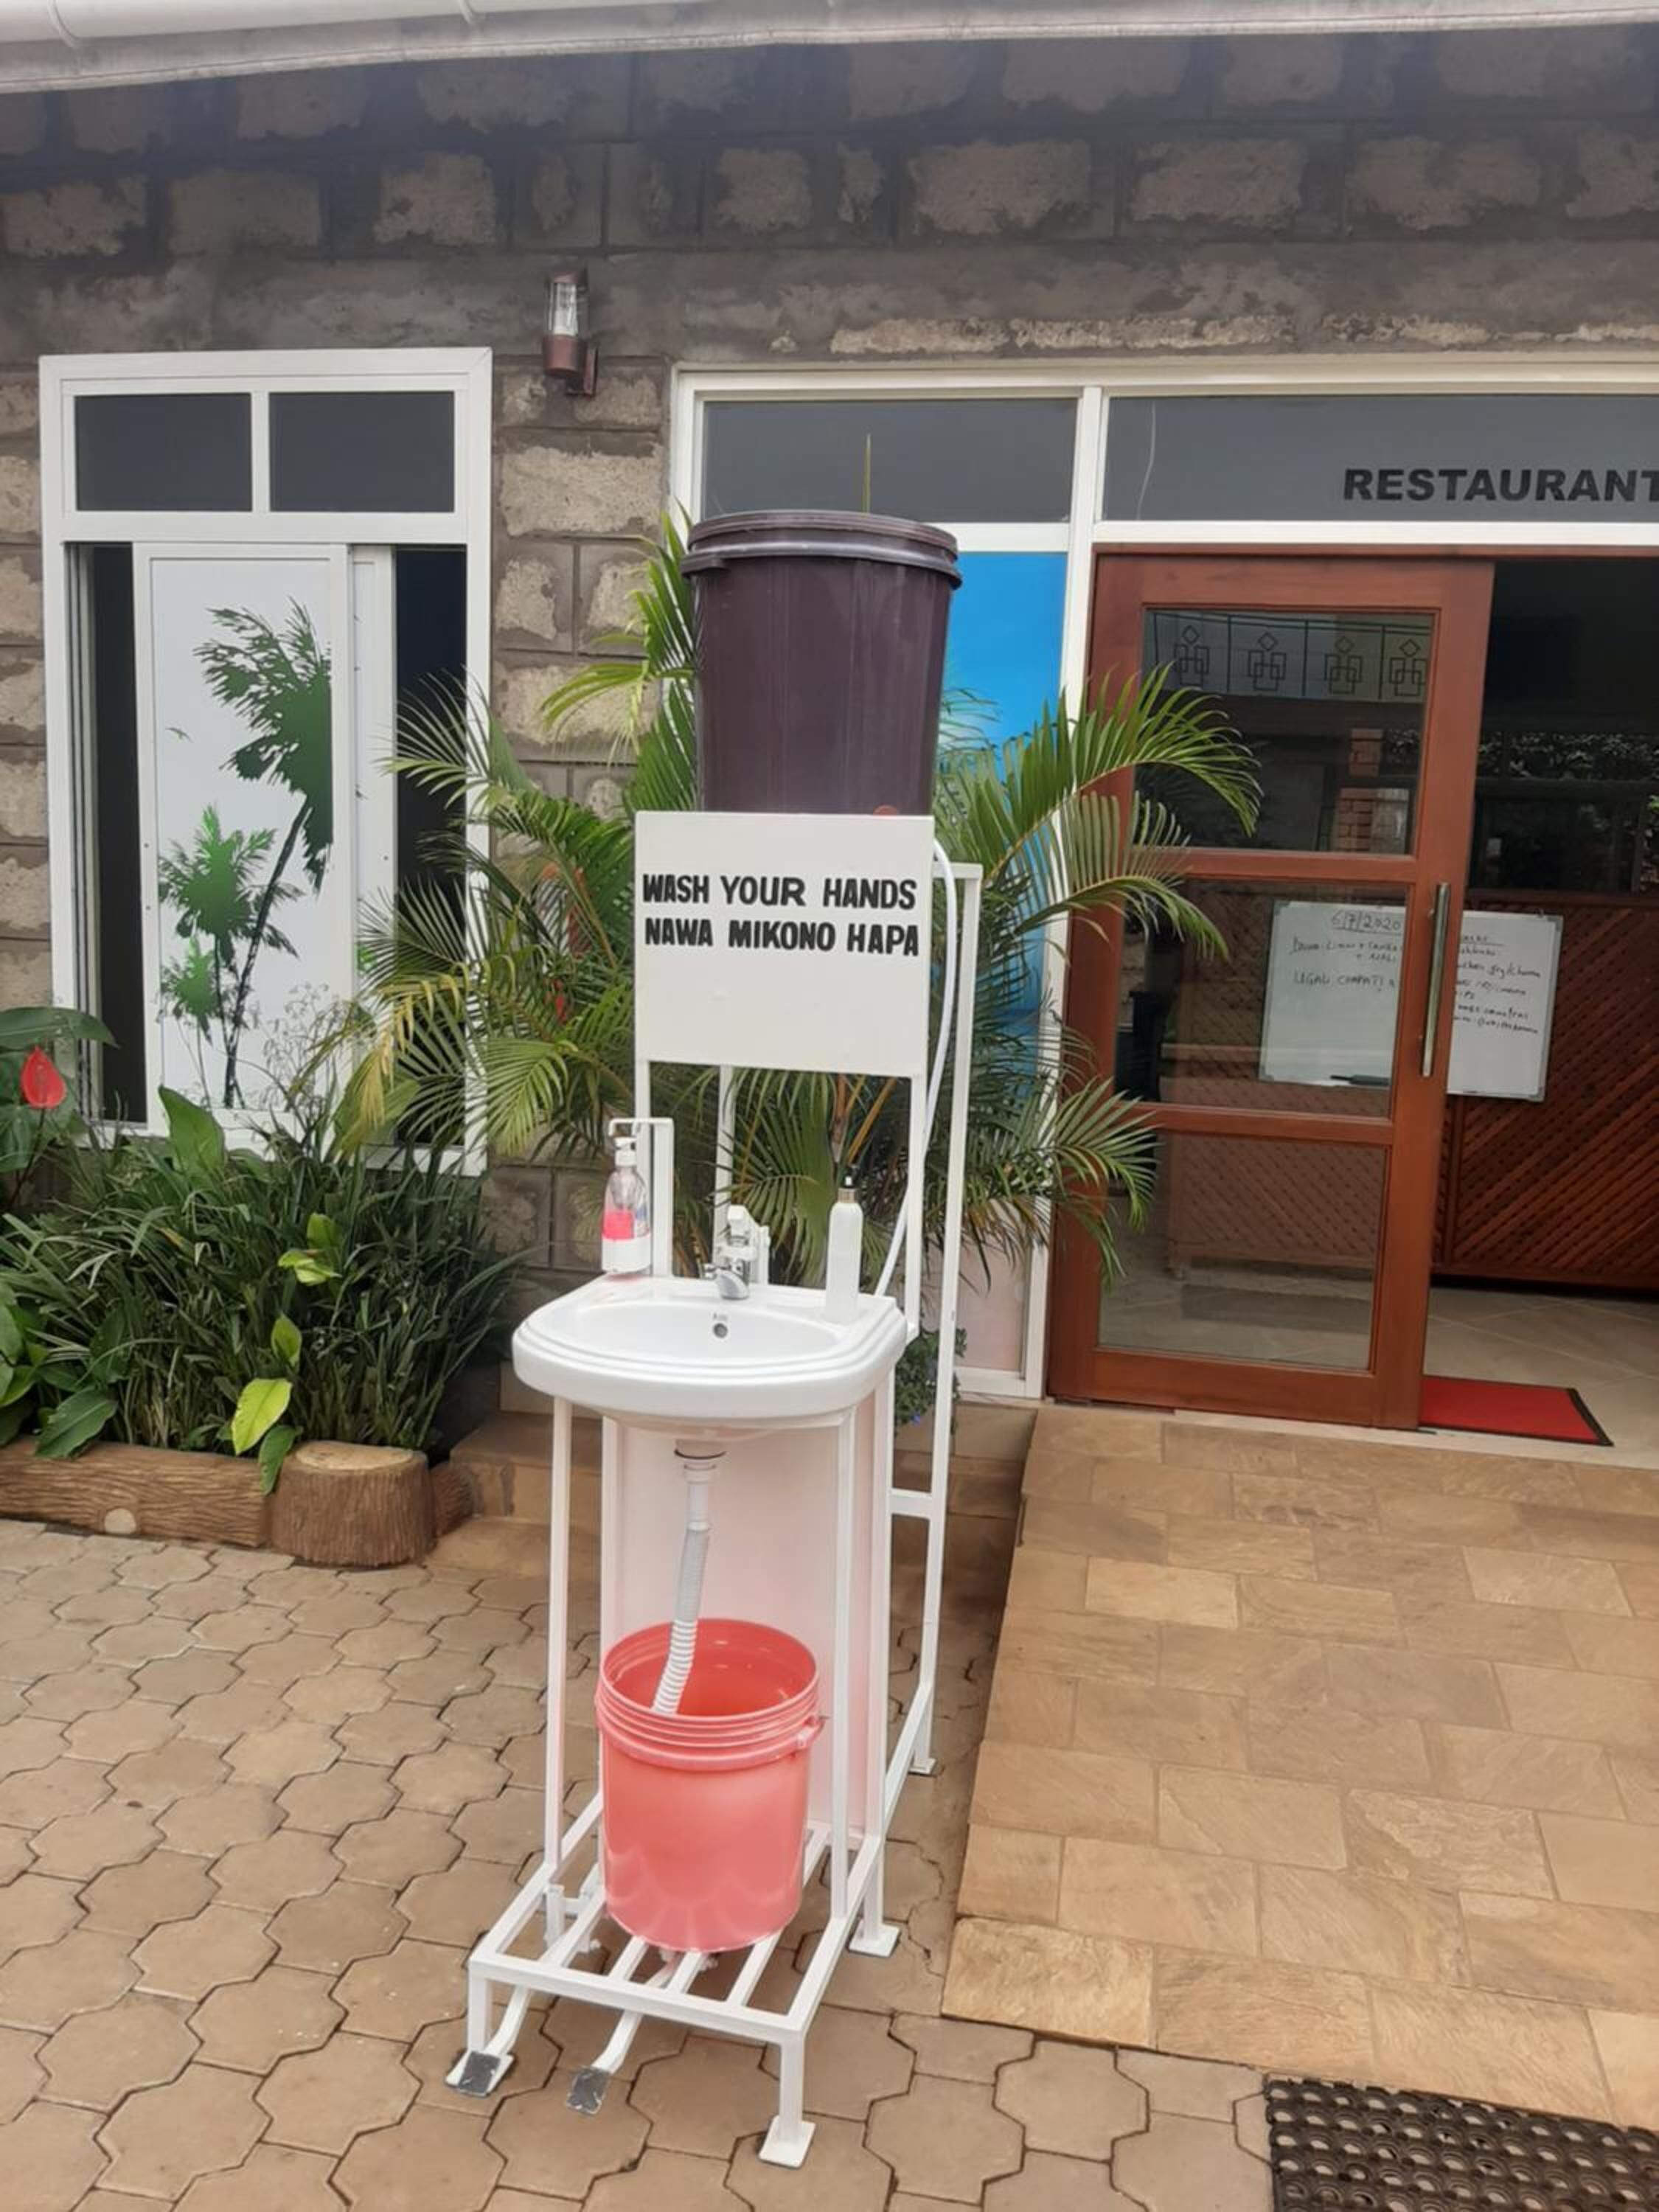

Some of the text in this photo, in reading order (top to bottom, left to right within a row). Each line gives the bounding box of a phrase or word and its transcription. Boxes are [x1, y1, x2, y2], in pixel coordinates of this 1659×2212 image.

[1343, 468, 1659, 501] RESTAURANT
[642, 874, 917, 910] WASH YOUR HANDS
[645, 918, 919, 956] NAWA MIKONO HAPA
